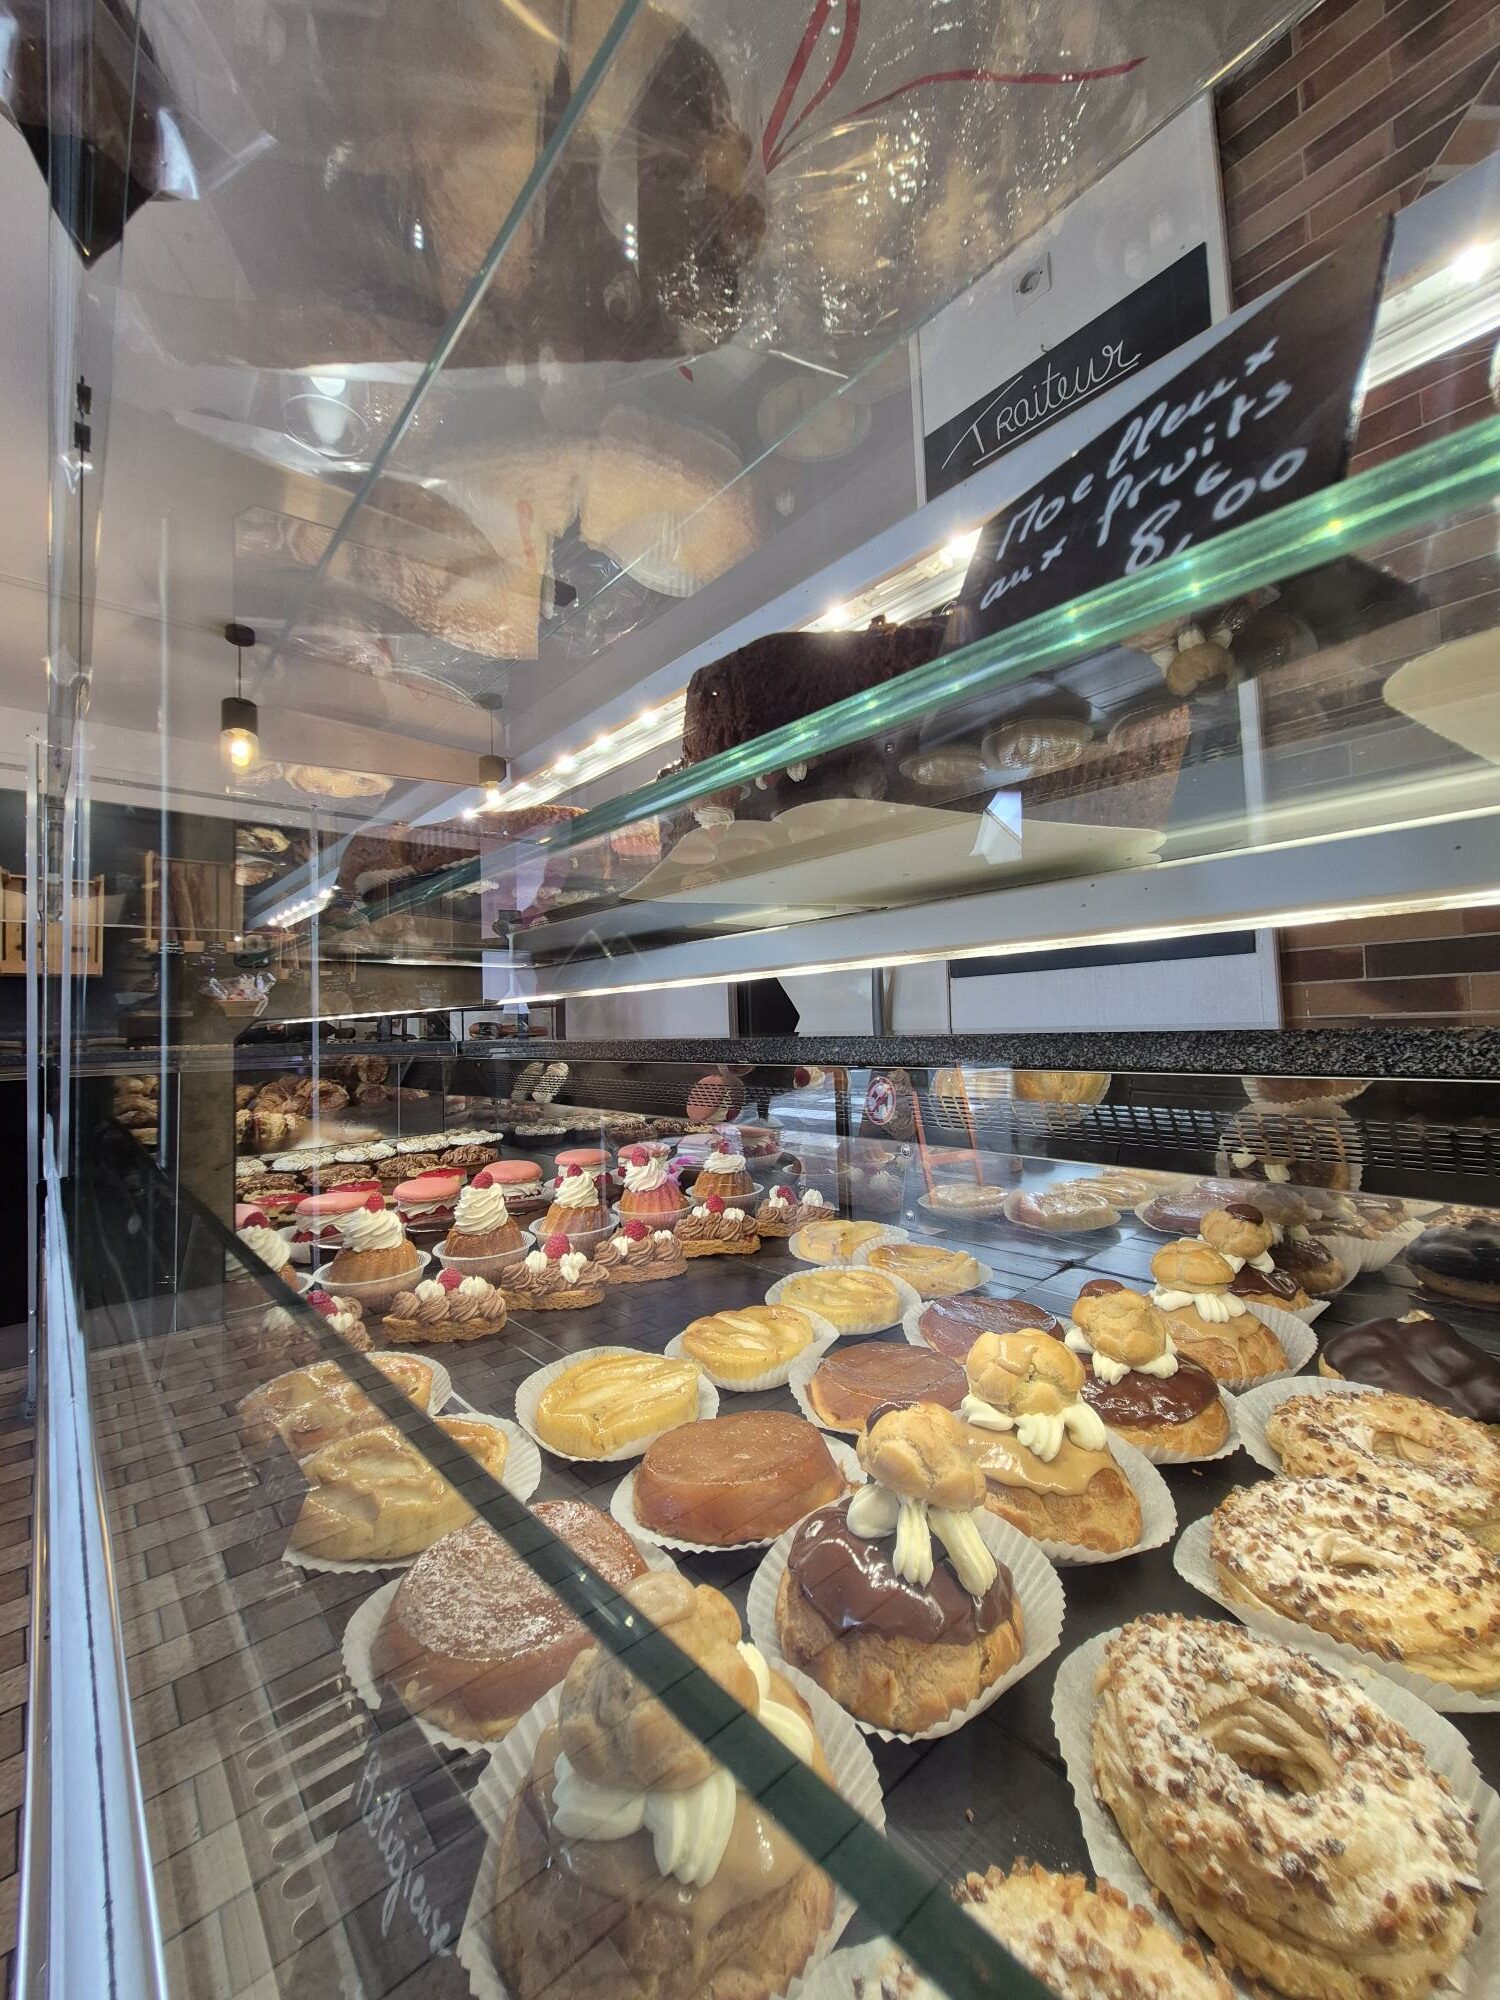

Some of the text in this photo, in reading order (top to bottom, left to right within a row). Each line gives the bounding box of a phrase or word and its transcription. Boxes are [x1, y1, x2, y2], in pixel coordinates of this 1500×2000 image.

[979, 379, 1292, 610] aux fruits
[997, 336, 1279, 561] Moelleux
